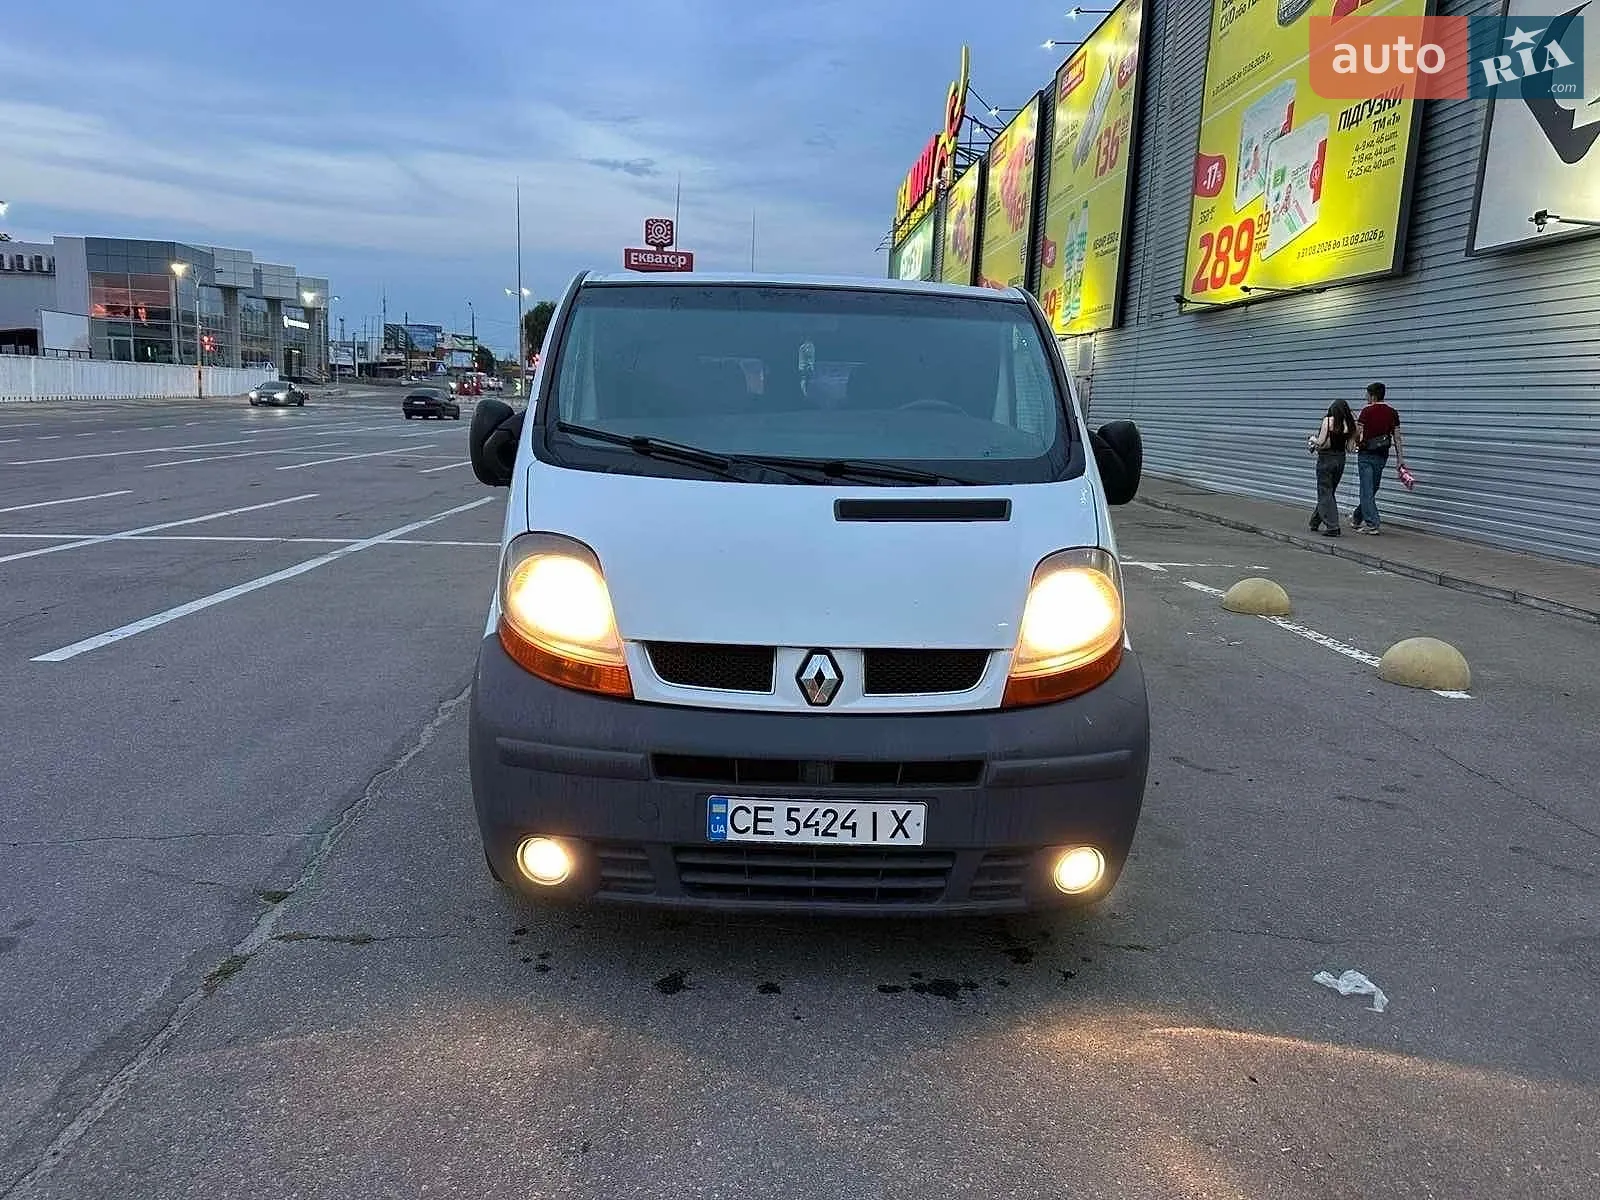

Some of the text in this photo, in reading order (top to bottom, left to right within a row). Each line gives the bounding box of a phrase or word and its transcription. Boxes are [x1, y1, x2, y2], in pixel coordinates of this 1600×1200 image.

[1337, 83, 1404, 132] ПІДГУЗКИ
[1256, 211, 1271, 235] 99
[630, 252, 687, 268] Екватор
[1191, 217, 1255, 295] 289
[711, 823, 726, 834] UA
[729, 805, 775, 836] CE
[784, 807, 857, 838] 5424
